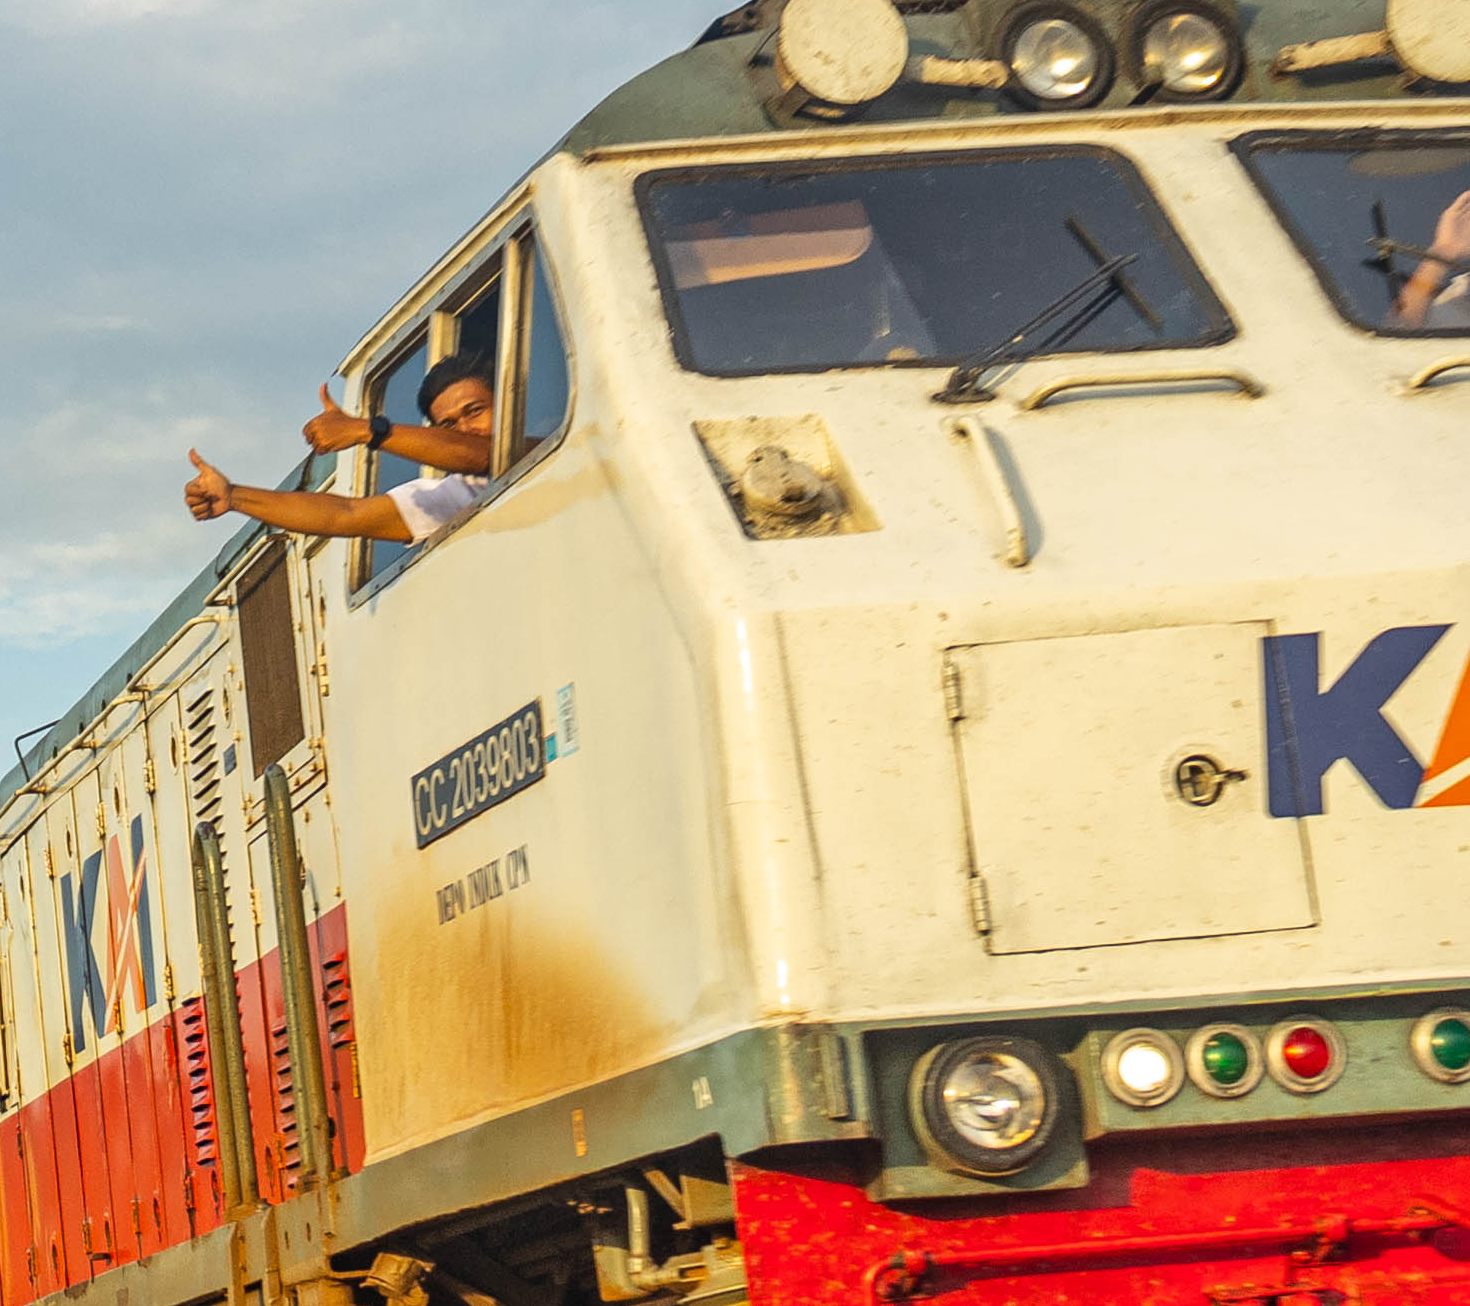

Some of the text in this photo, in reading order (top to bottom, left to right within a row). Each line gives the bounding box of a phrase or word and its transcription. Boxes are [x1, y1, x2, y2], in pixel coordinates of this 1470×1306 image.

[415, 768, 448, 836] CC
[449, 710, 541, 819] 2039803
[60, 813, 157, 1055] KAI
